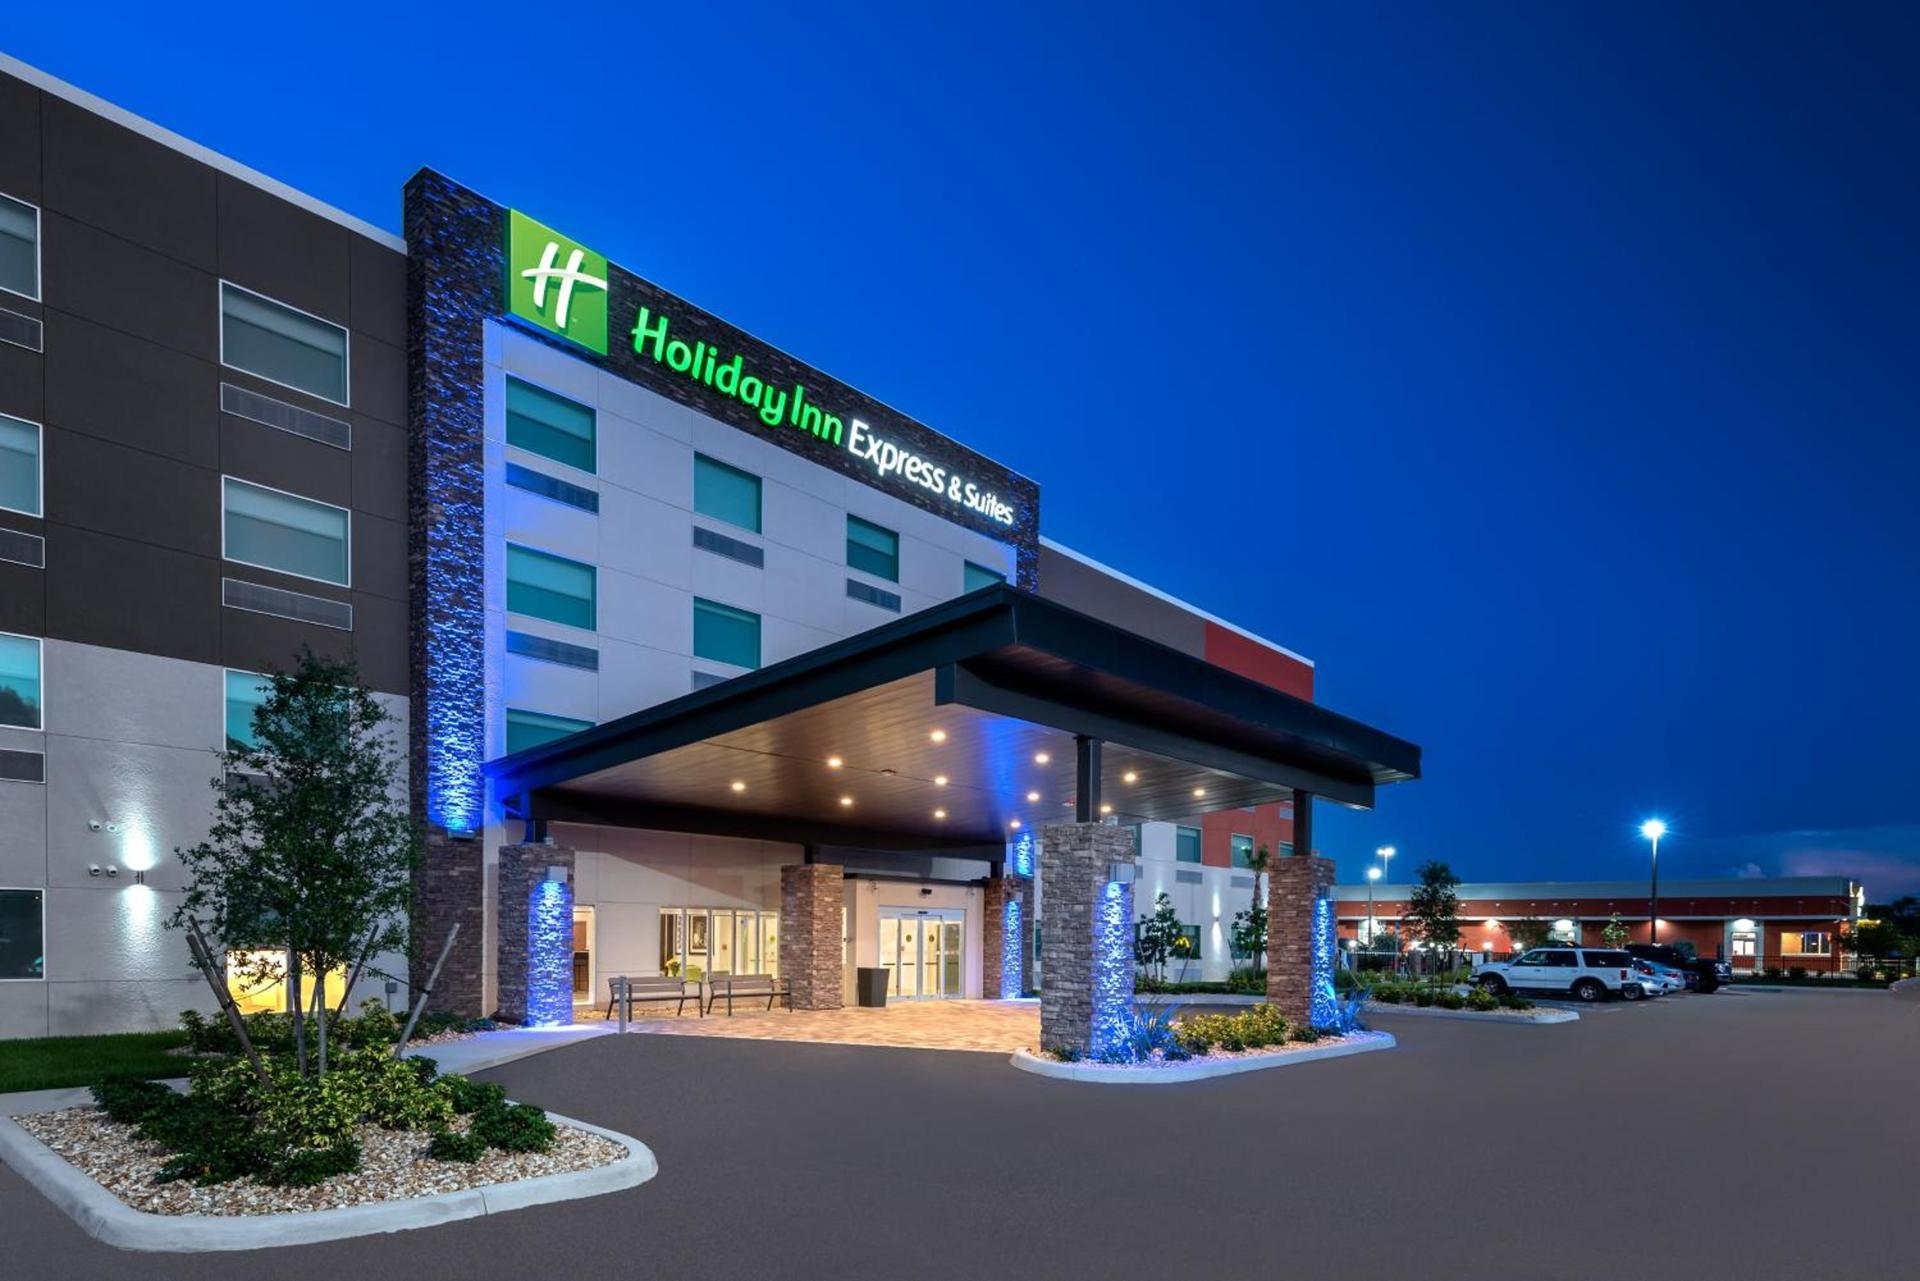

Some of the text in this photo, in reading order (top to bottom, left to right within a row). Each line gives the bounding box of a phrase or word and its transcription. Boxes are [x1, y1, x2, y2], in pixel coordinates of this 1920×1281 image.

[521, 241, 607, 329] H
[631, 306, 1014, 526] Holiday Inn Express & Suites
